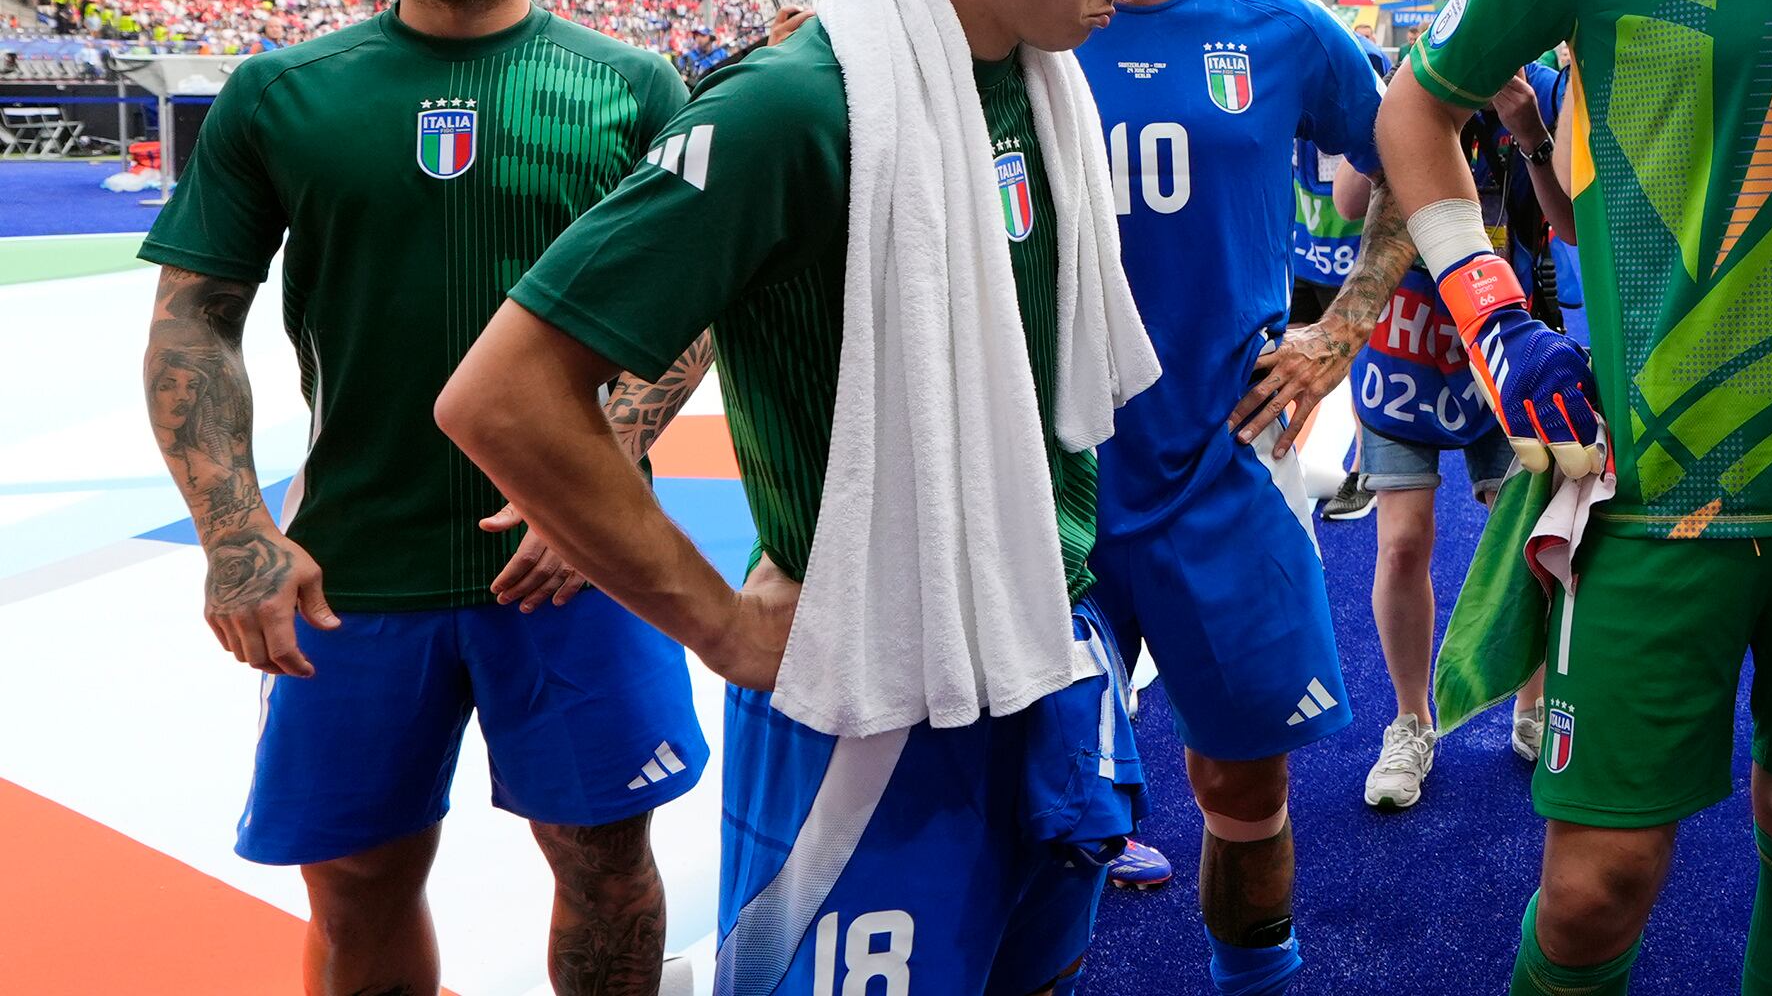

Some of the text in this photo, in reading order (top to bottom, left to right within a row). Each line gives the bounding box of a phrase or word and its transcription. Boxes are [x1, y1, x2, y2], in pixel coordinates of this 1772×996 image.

[1208, 57, 1246, 70] ITALIA
[423, 116, 471, 129] ITALIA
[1109, 121, 1190, 215] 10
[1299, 187, 1322, 232] V
[813, 910, 915, 996] 18
